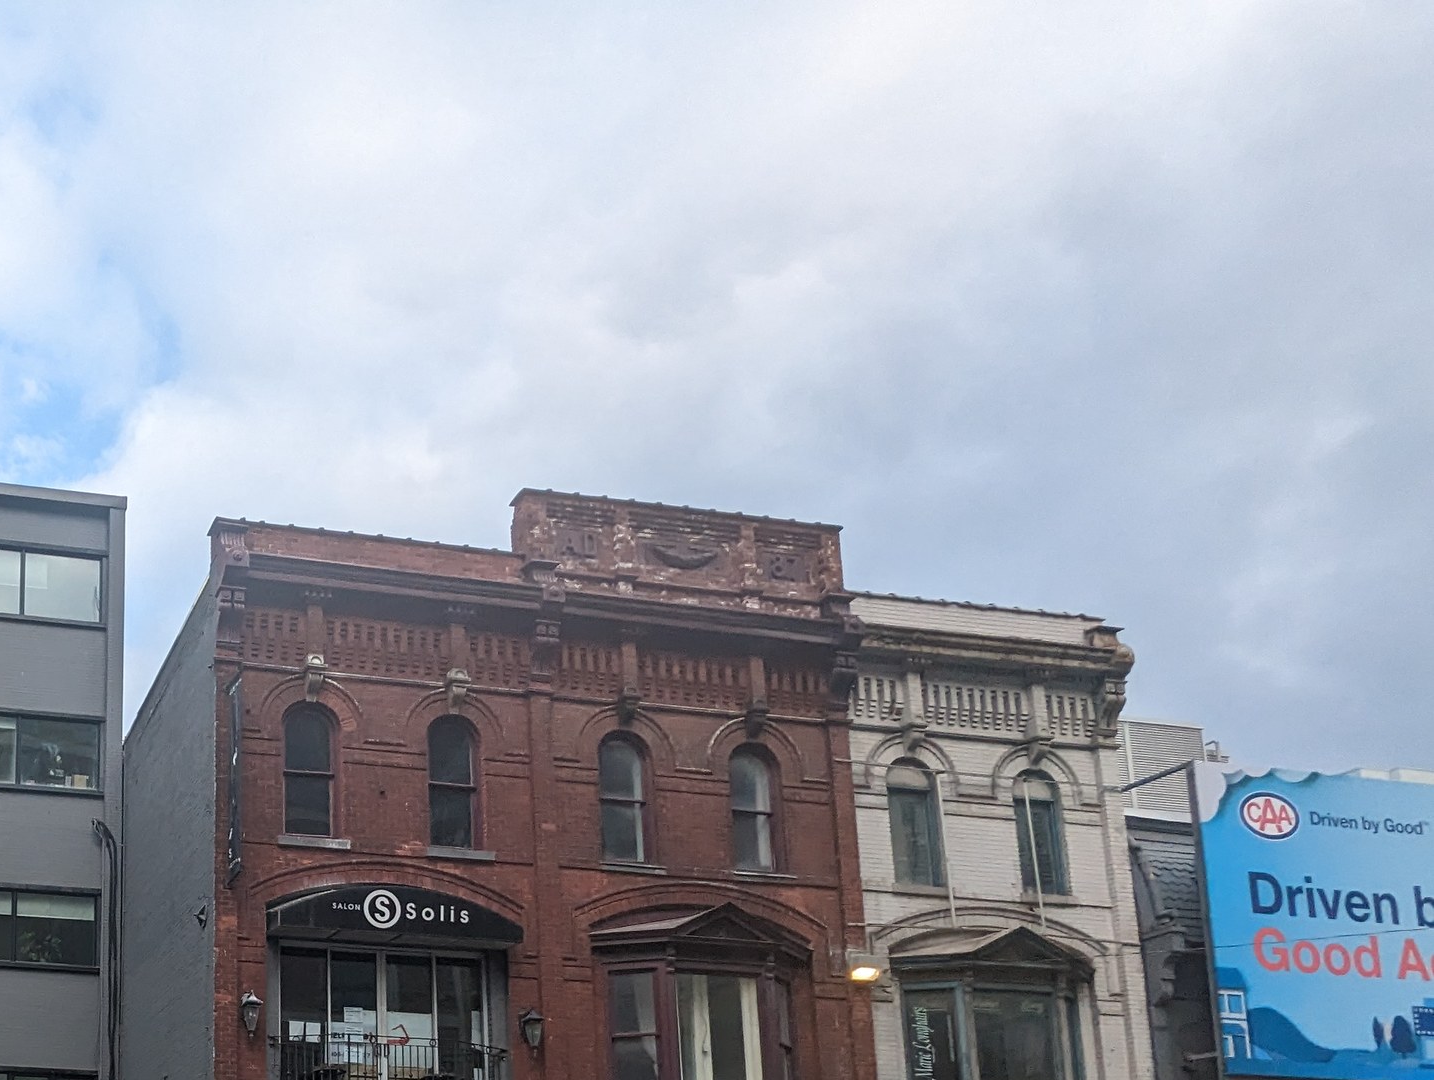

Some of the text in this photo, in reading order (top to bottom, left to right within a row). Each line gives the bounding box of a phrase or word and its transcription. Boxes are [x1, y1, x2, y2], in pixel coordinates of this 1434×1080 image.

[1246, 798, 1293, 833] CAA
[1309, 811, 1359, 830] Driven
[1361, 816, 1380, 835] by
[332, 896, 470, 924] SALON S Solis
[1248, 871, 1400, 925] Driven
[1253, 927, 1434, 982] Good A
